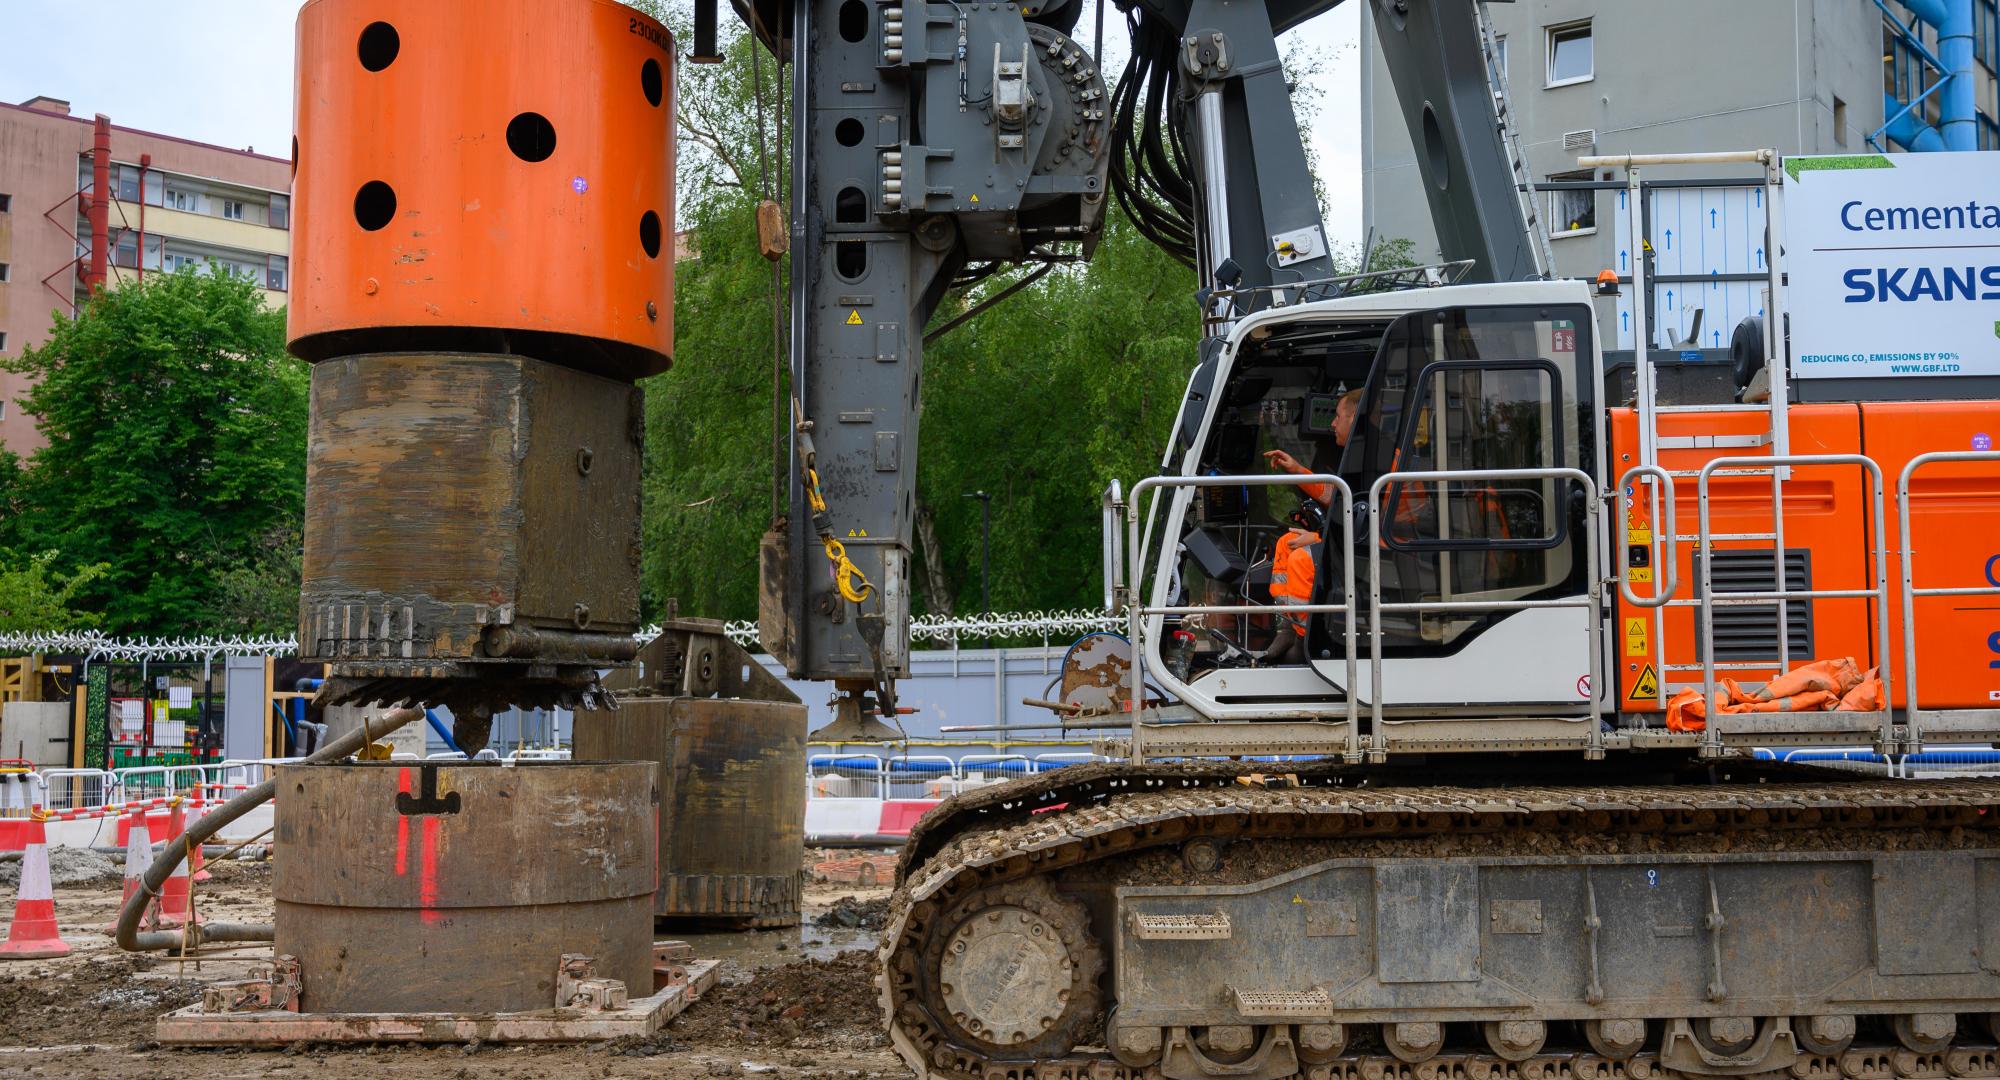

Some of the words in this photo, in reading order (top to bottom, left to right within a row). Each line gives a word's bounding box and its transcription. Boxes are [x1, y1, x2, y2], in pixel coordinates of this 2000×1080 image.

[1841, 201, 2000, 231] Cementa
[1843, 266, 2000, 303] SKANS
[1801, 354, 1849, 363] REDUCING
[1869, 353, 1922, 362] EMISSIONS
[1923, 352, 1936, 361] BY
[1938, 352, 1960, 361] 90%
[1891, 364, 1960, 373] WWW.GBF.LTD
